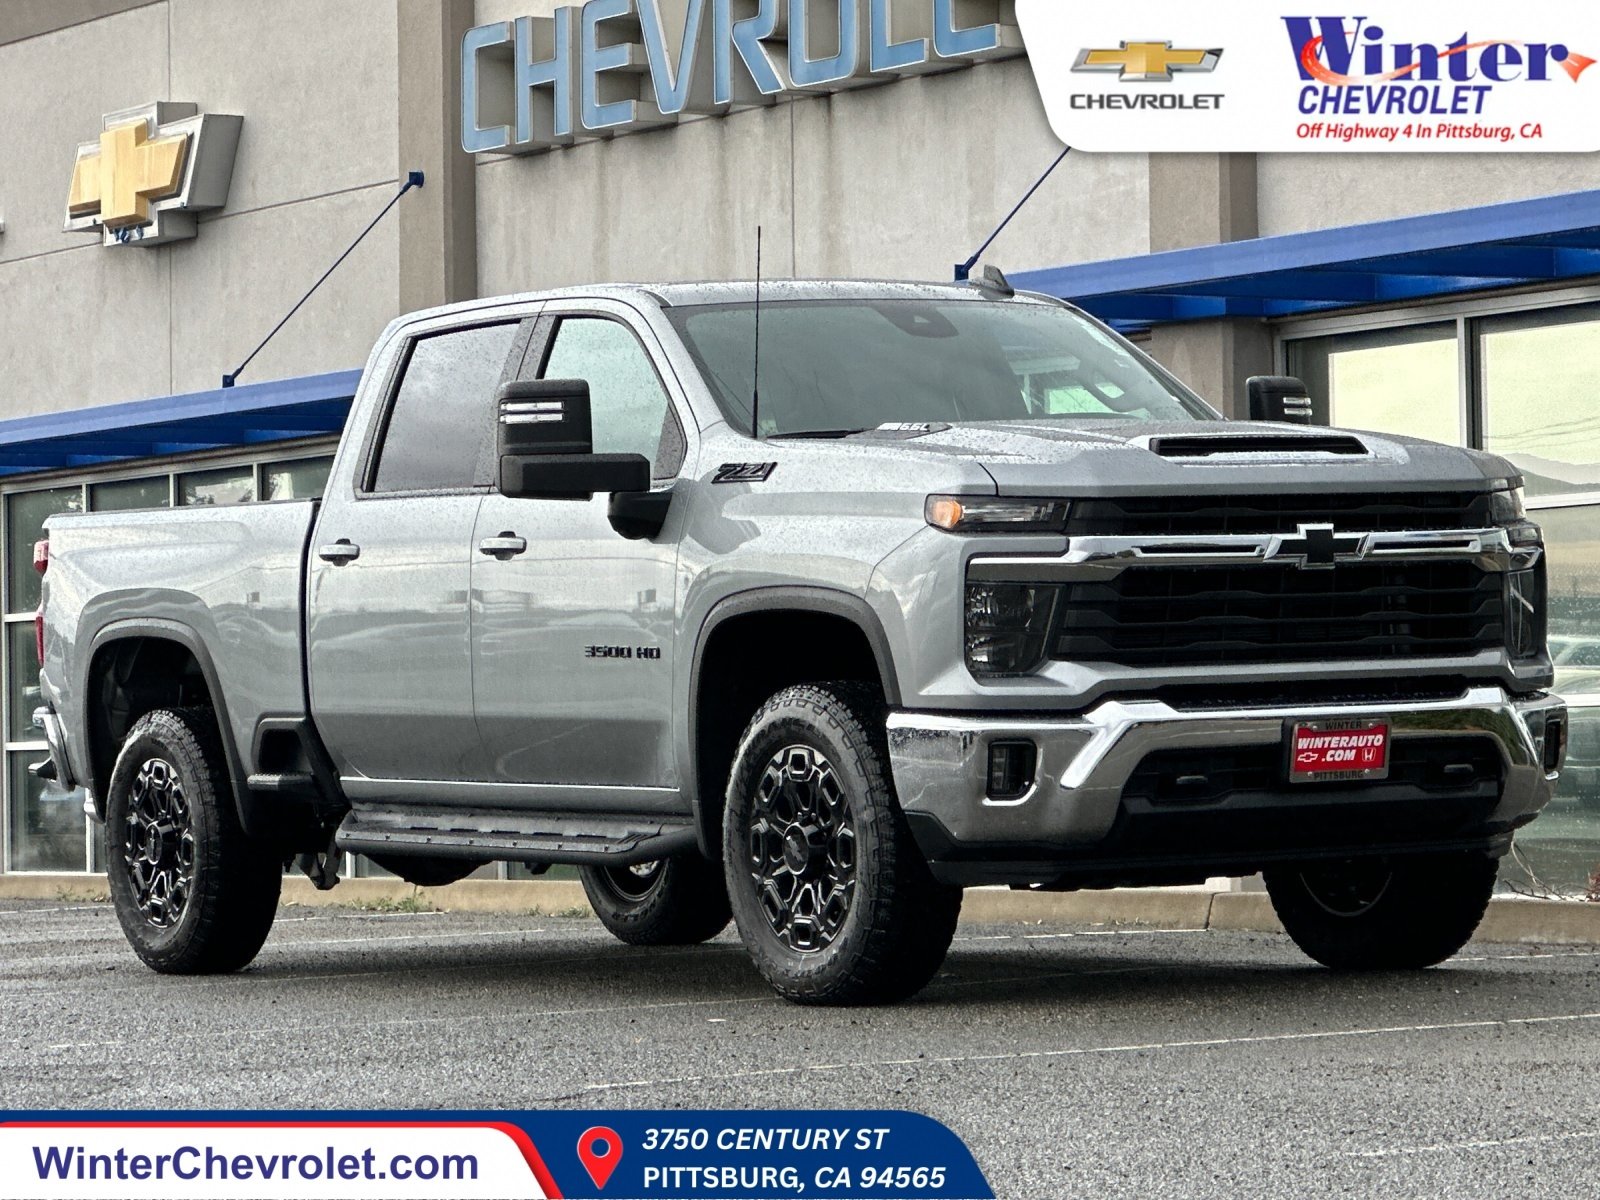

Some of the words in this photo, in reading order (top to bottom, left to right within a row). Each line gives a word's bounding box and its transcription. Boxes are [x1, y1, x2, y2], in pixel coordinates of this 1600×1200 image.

[584, 645, 632, 659] 3500
[637, 646, 661, 659] HD
[1325, 720, 1362, 731] WINTER
[1297, 734, 1384, 750] WINTERAUTO
[1321, 749, 1357, 762] .COM
[1314, 769, 1364, 780] PITTSBURG
